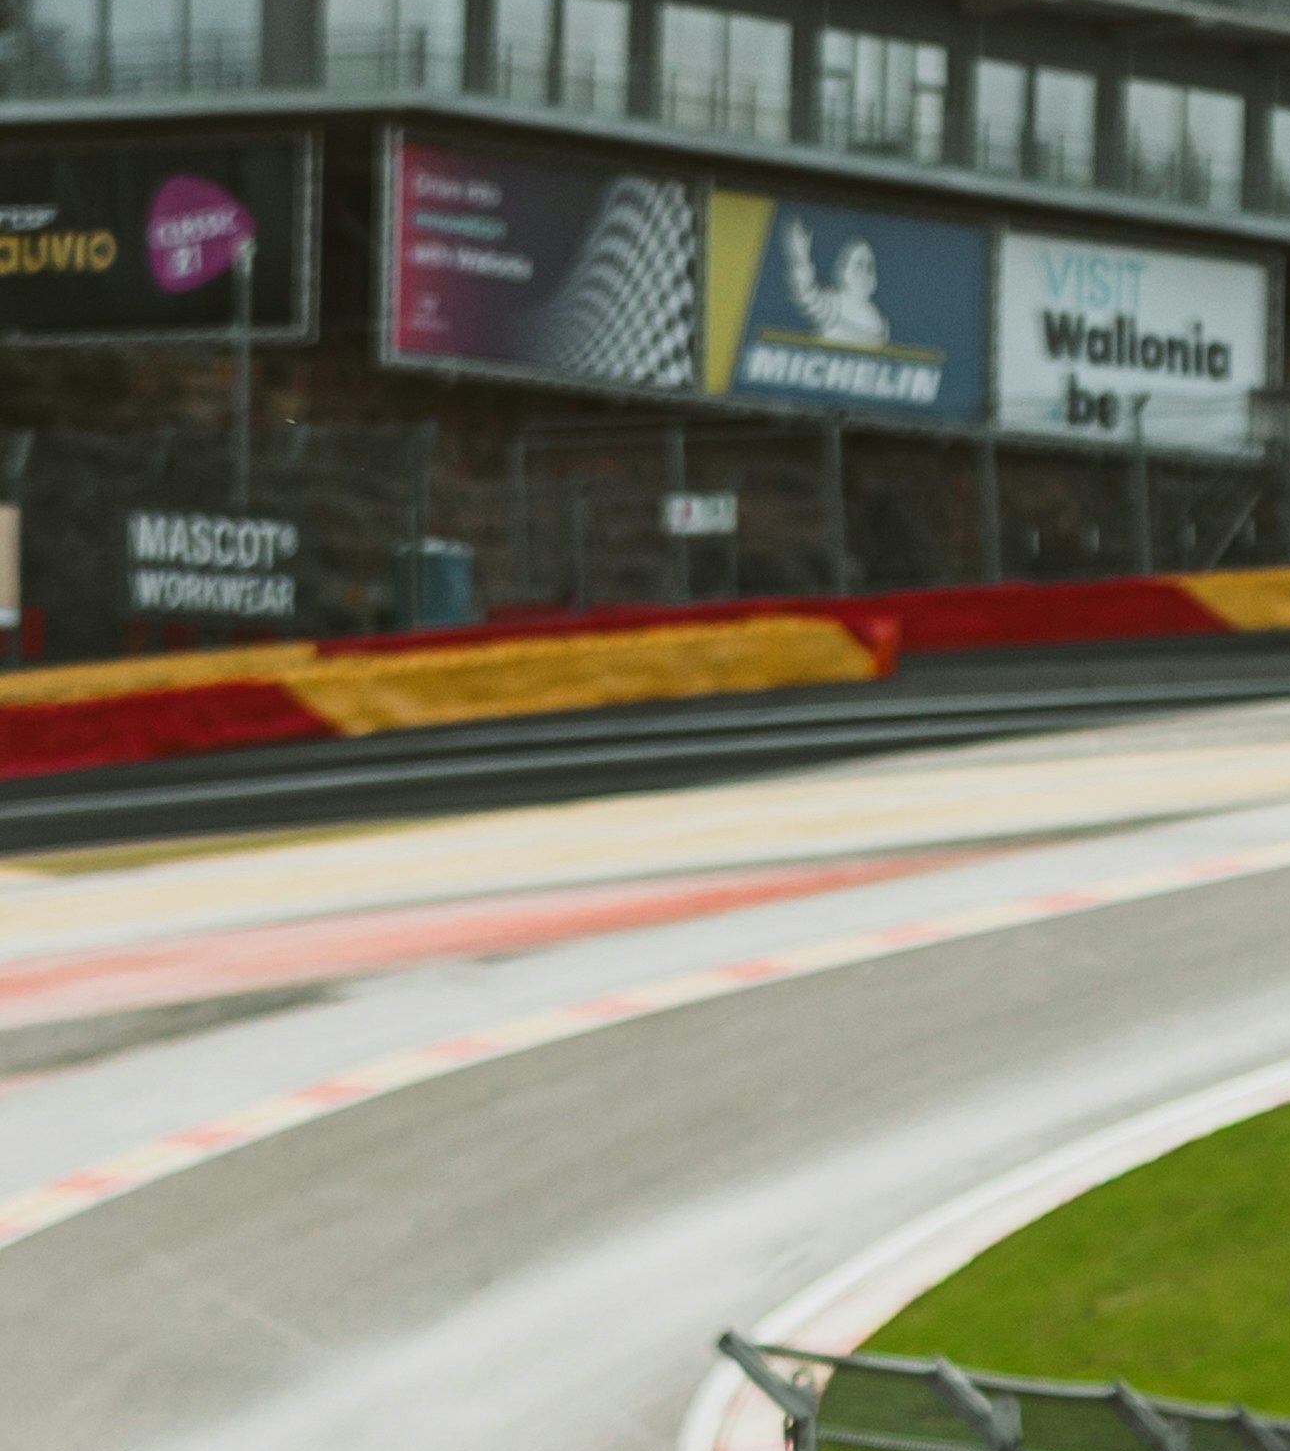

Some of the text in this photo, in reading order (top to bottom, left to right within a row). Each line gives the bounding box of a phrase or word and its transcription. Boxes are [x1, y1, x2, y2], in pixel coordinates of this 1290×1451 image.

[1042, 252, 1145, 309] VISIT
[1043, 311, 1229, 380] Wallonia
[749, 347, 942, 405] MICHELIN
[133, 569, 296, 616] WORKWEAR
